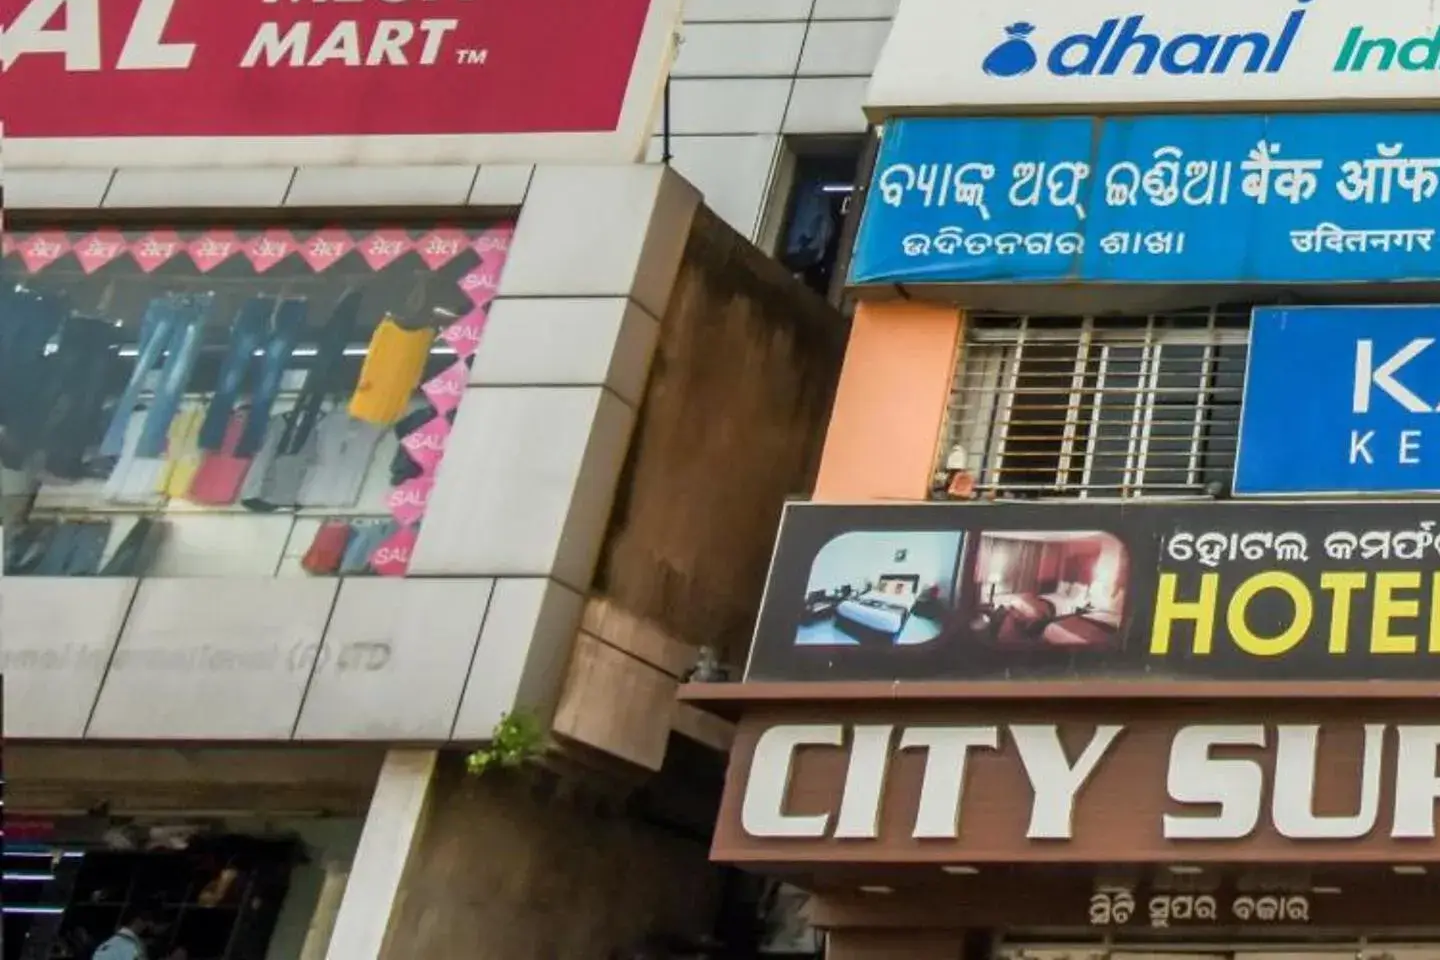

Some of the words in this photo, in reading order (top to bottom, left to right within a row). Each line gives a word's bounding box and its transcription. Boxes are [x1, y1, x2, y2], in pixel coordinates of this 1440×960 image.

[240, 19, 457, 67] MART
[1105, 146, 1232, 207] ଇଣ୍ଡିଆ
[1240, 140, 1323, 204] बैंक
[474, 237, 507, 252] SAL
[902, 226, 1084, 256] ଉଦିତନଗର
[1099, 231, 1184, 254] ଶାଖା
[1290, 222, 1435, 253] उदितनगर
[464, 273, 497, 289] SAL
[446, 325, 478, 342] SAL
[428, 379, 460, 393] SAL
[409, 433, 443, 449] SAL
[389, 491, 425, 507] SAL
[374, 548, 409, 564] SAL
[1167, 532, 1309, 567] ହୋଟଲ
[739, 723, 1126, 839] CITY
